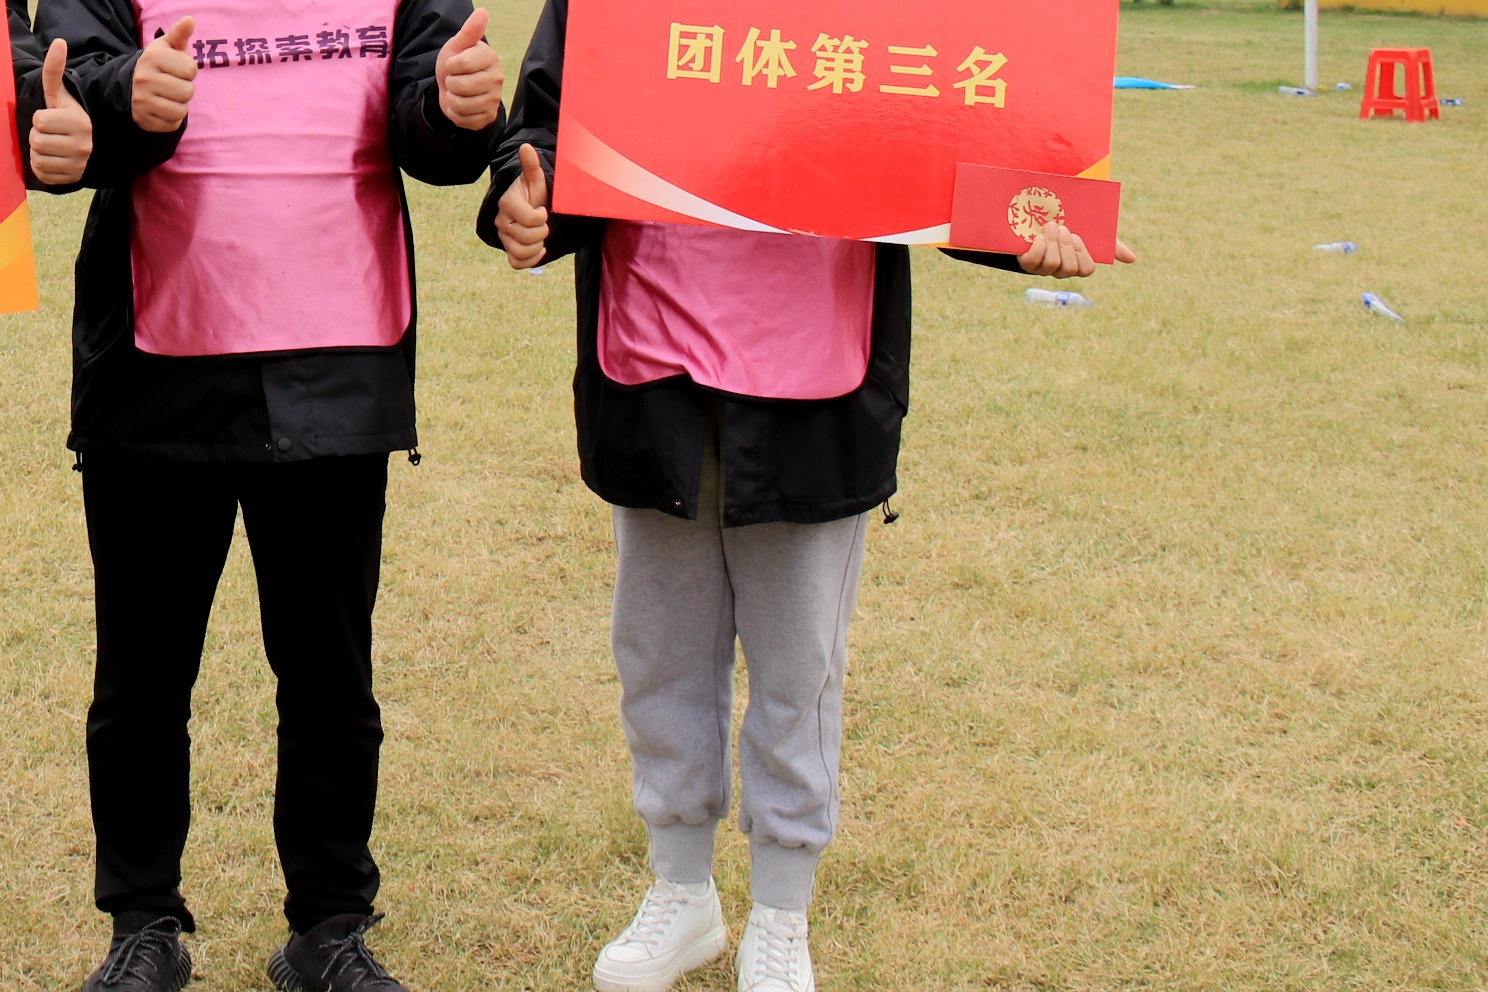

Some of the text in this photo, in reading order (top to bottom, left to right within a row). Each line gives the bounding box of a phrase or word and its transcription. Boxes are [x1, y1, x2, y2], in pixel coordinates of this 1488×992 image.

[154, 25, 389, 69] 拓探索教育
[666, 22, 1009, 109] 团体第三名
